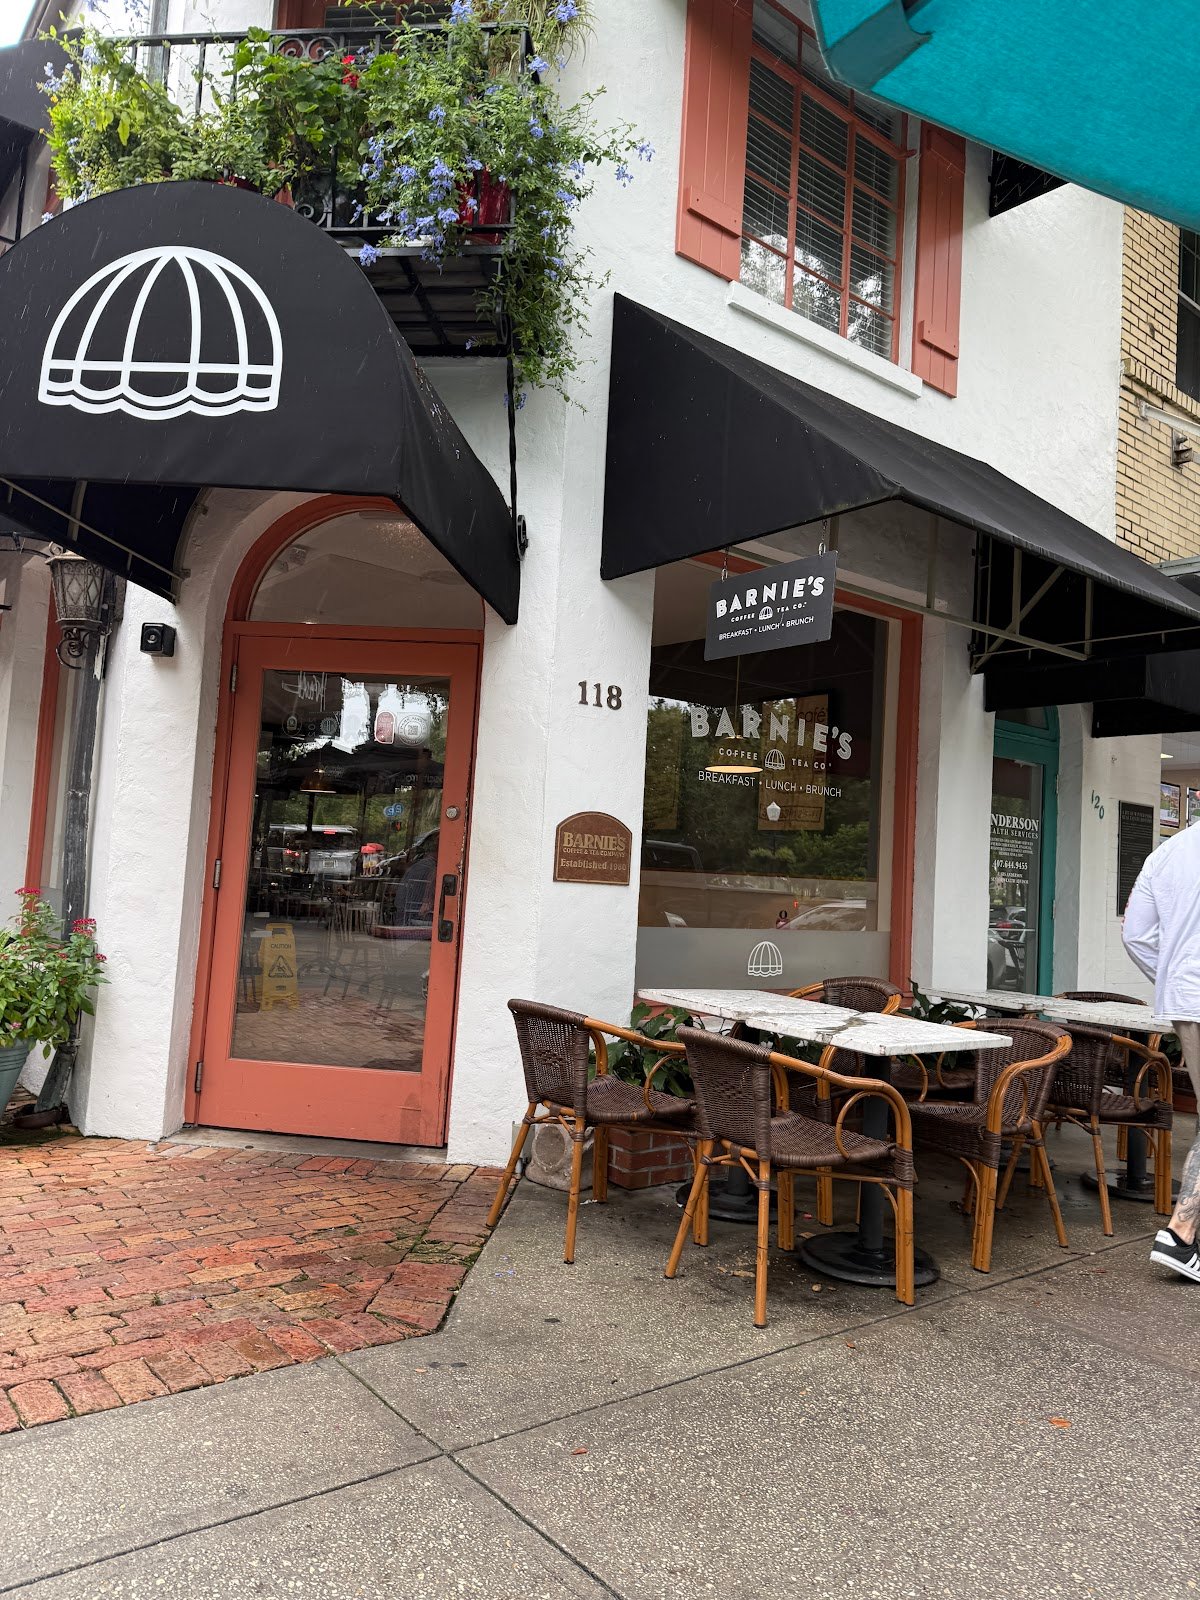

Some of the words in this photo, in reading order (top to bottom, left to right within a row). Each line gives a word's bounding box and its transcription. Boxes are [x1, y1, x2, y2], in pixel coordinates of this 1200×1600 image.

[716, 575, 826, 619] BARNIE'S
[718, 627, 753, 641] BREAKFAST
[758, 622, 780, 634] LUNCH
[786, 615, 815, 628] BRUNCH
[730, 612, 756, 623] COFFEE
[578, 680, 622, 711] 118
[690, 706, 853, 760] BARNIE'S
[718, 747, 759, 761] COFFEE
[791, 758, 809, 768] TEA
[698, 770, 756, 787] BREAKFAST
[765, 779, 797, 792] LUNCH
[805, 784, 842, 798] BRUNCH
[1091, 789, 1105, 820] 120
[990, 814, 1039, 831] NDERSON
[992, 828, 1009, 836] ALTH
[1011, 829, 1039, 840] SERVICES
[562, 831, 626, 852] BARNIE'S
[560, 858, 607, 870] Established
